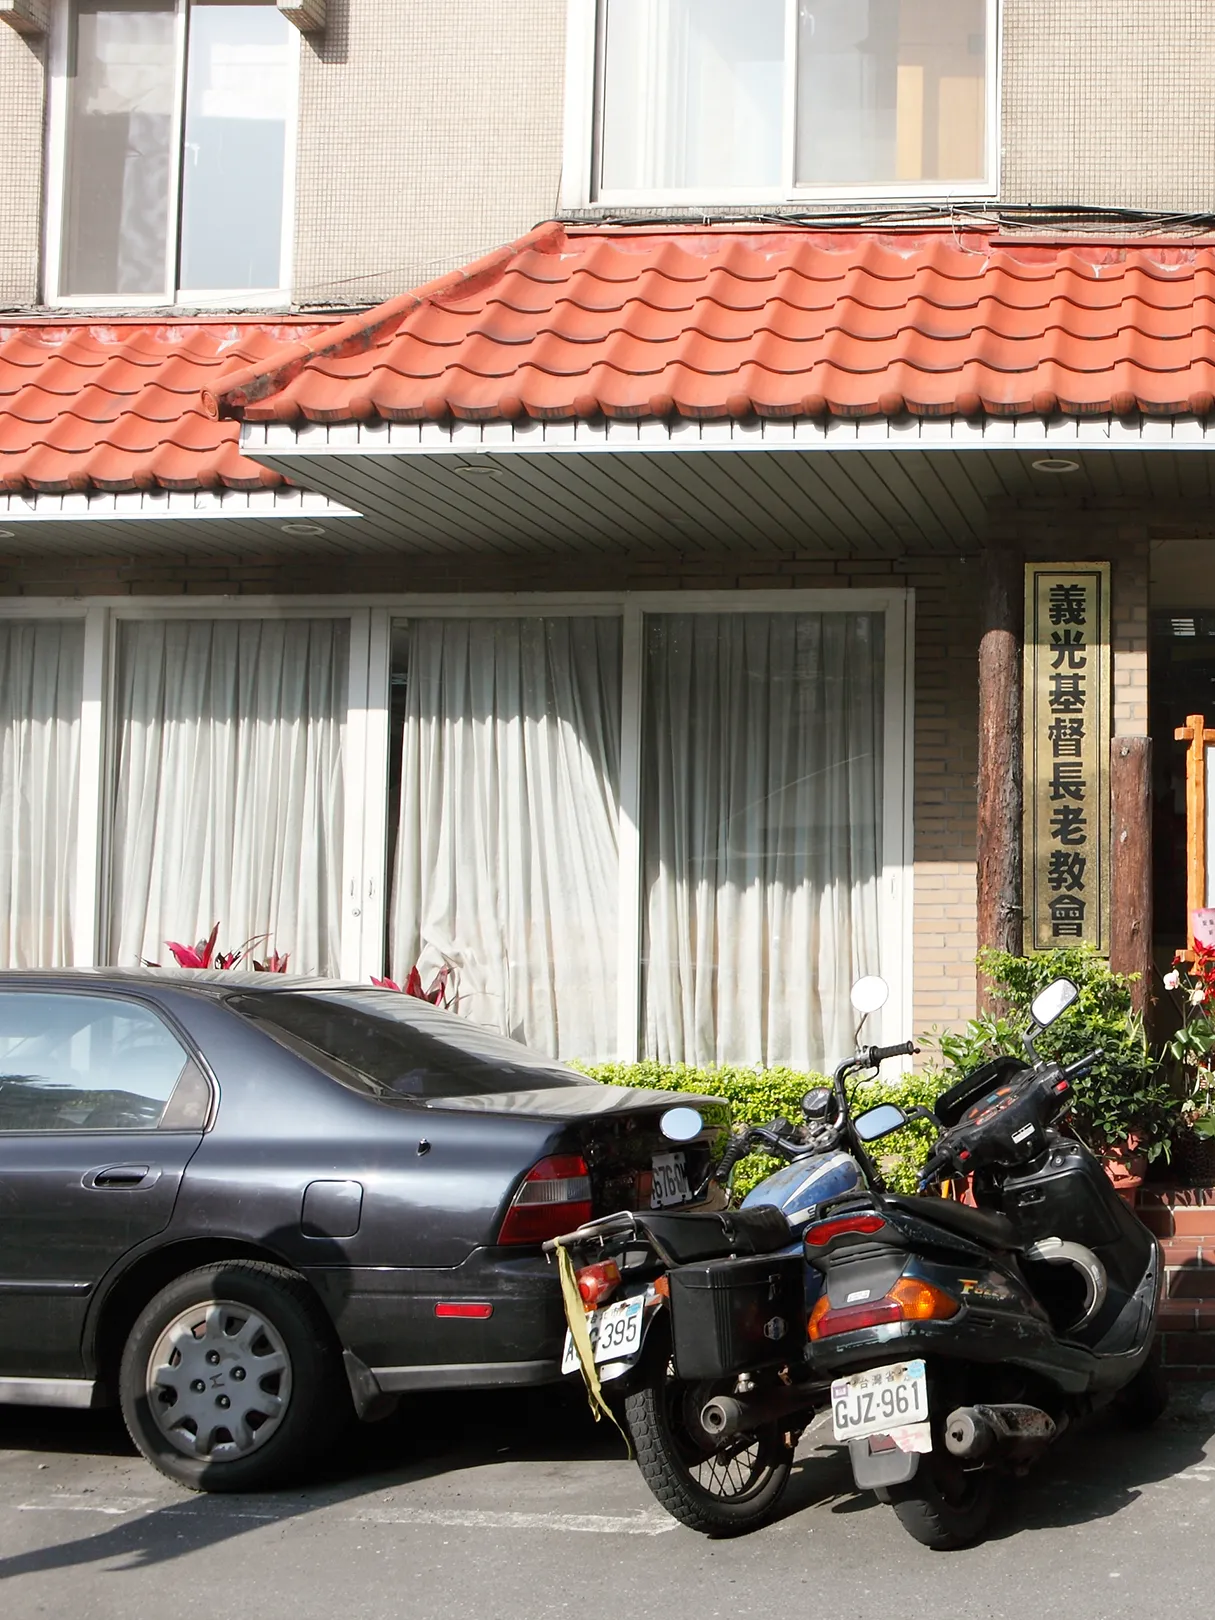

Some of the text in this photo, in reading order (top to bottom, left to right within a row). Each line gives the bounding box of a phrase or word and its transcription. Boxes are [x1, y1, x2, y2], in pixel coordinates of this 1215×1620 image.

[1048, 584, 1087, 938] 義光基督長老教會
[565, 1315, 637, 1363] A-395
[835, 1380, 919, 1429] GJZ-961
